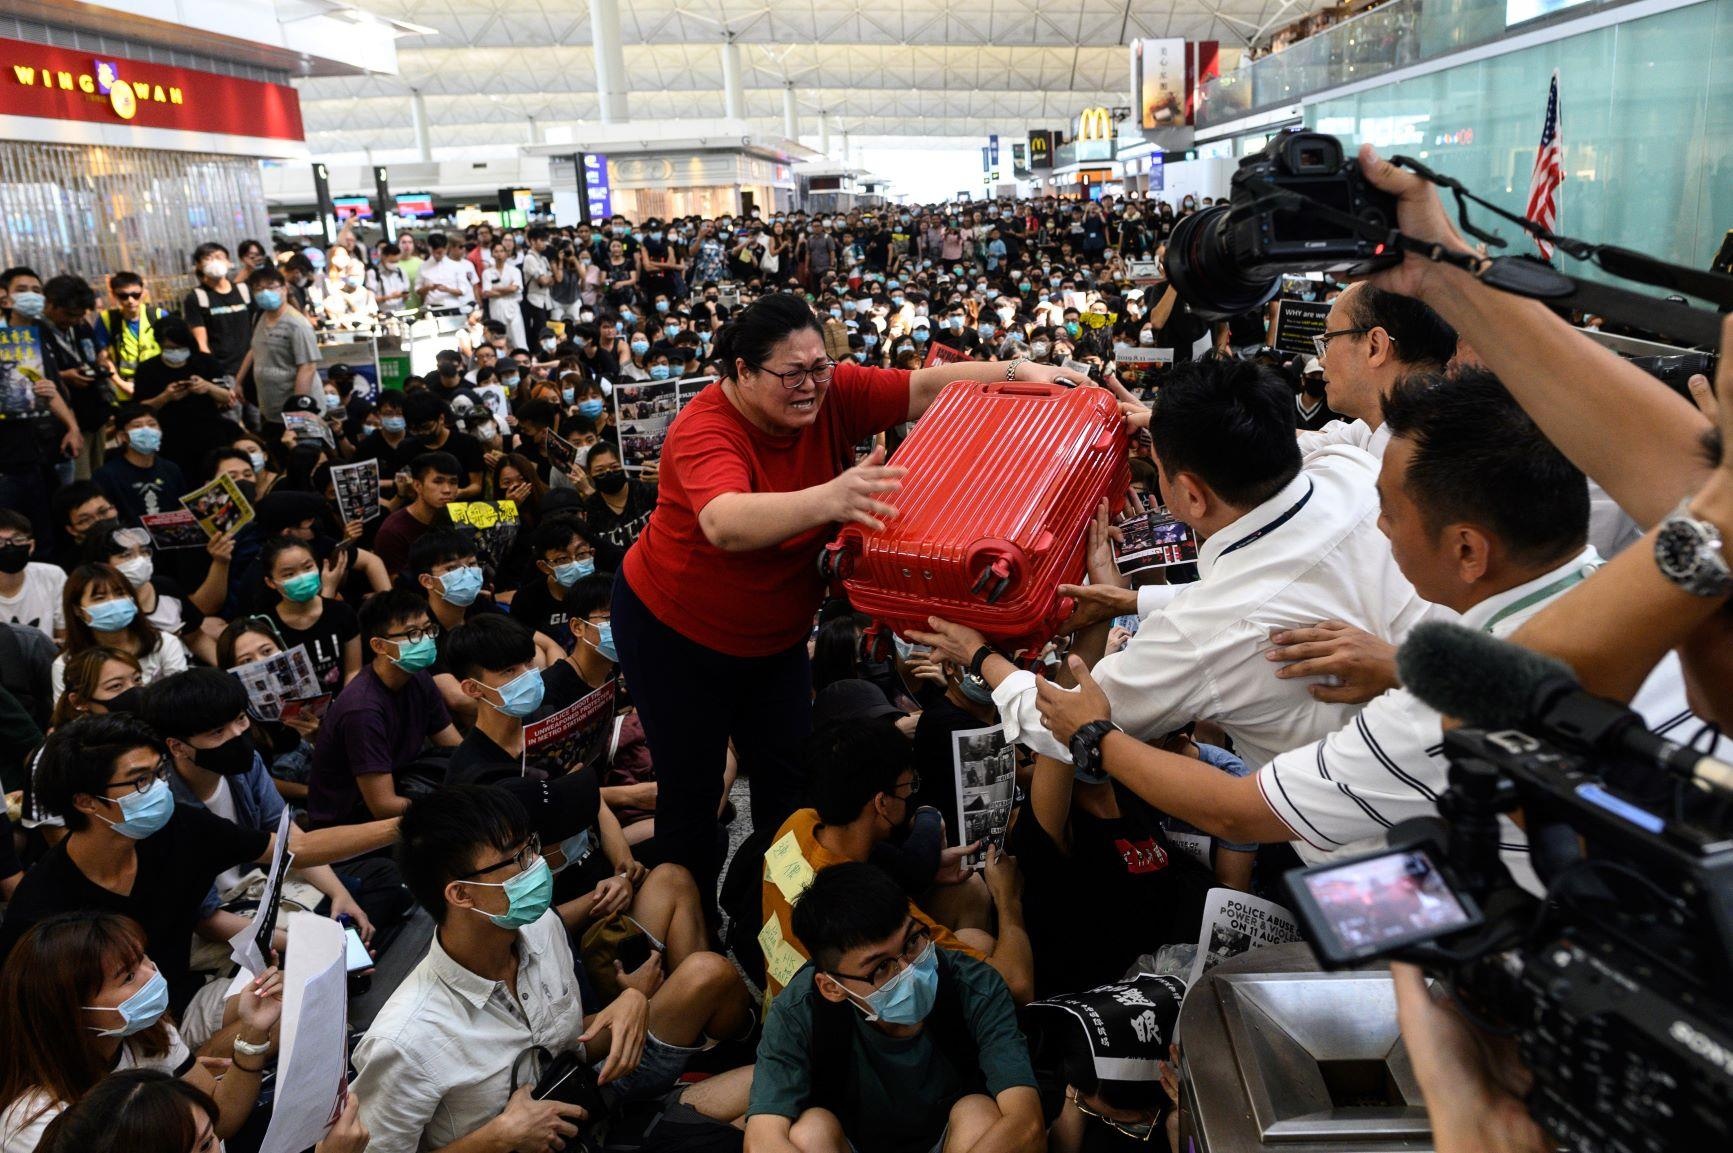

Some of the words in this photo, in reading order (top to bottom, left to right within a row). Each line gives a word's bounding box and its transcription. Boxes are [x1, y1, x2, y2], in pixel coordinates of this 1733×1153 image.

[13, 65, 95, 94] WING
[132, 81, 183, 105] WAN
[1285, 309, 1302, 317] WHY
[534, 710, 580, 737] UNWEAPONED
[545, 711, 570, 725] POLICE
[571, 698, 590, 712] SHOOT
[537, 727, 562, 742] METRO
[562, 714, 587, 731] STATION
[1220, 907, 1258, 927] POWER
[1259, 921, 1267, 931] &
[1227, 900, 1266, 920] POLICE
[1266, 915, 1295, 934] ABUSE
[1230, 919, 1247, 933] ON
[1249, 926, 1258, 937] 11
[1259, 933, 1281, 945] AUG
